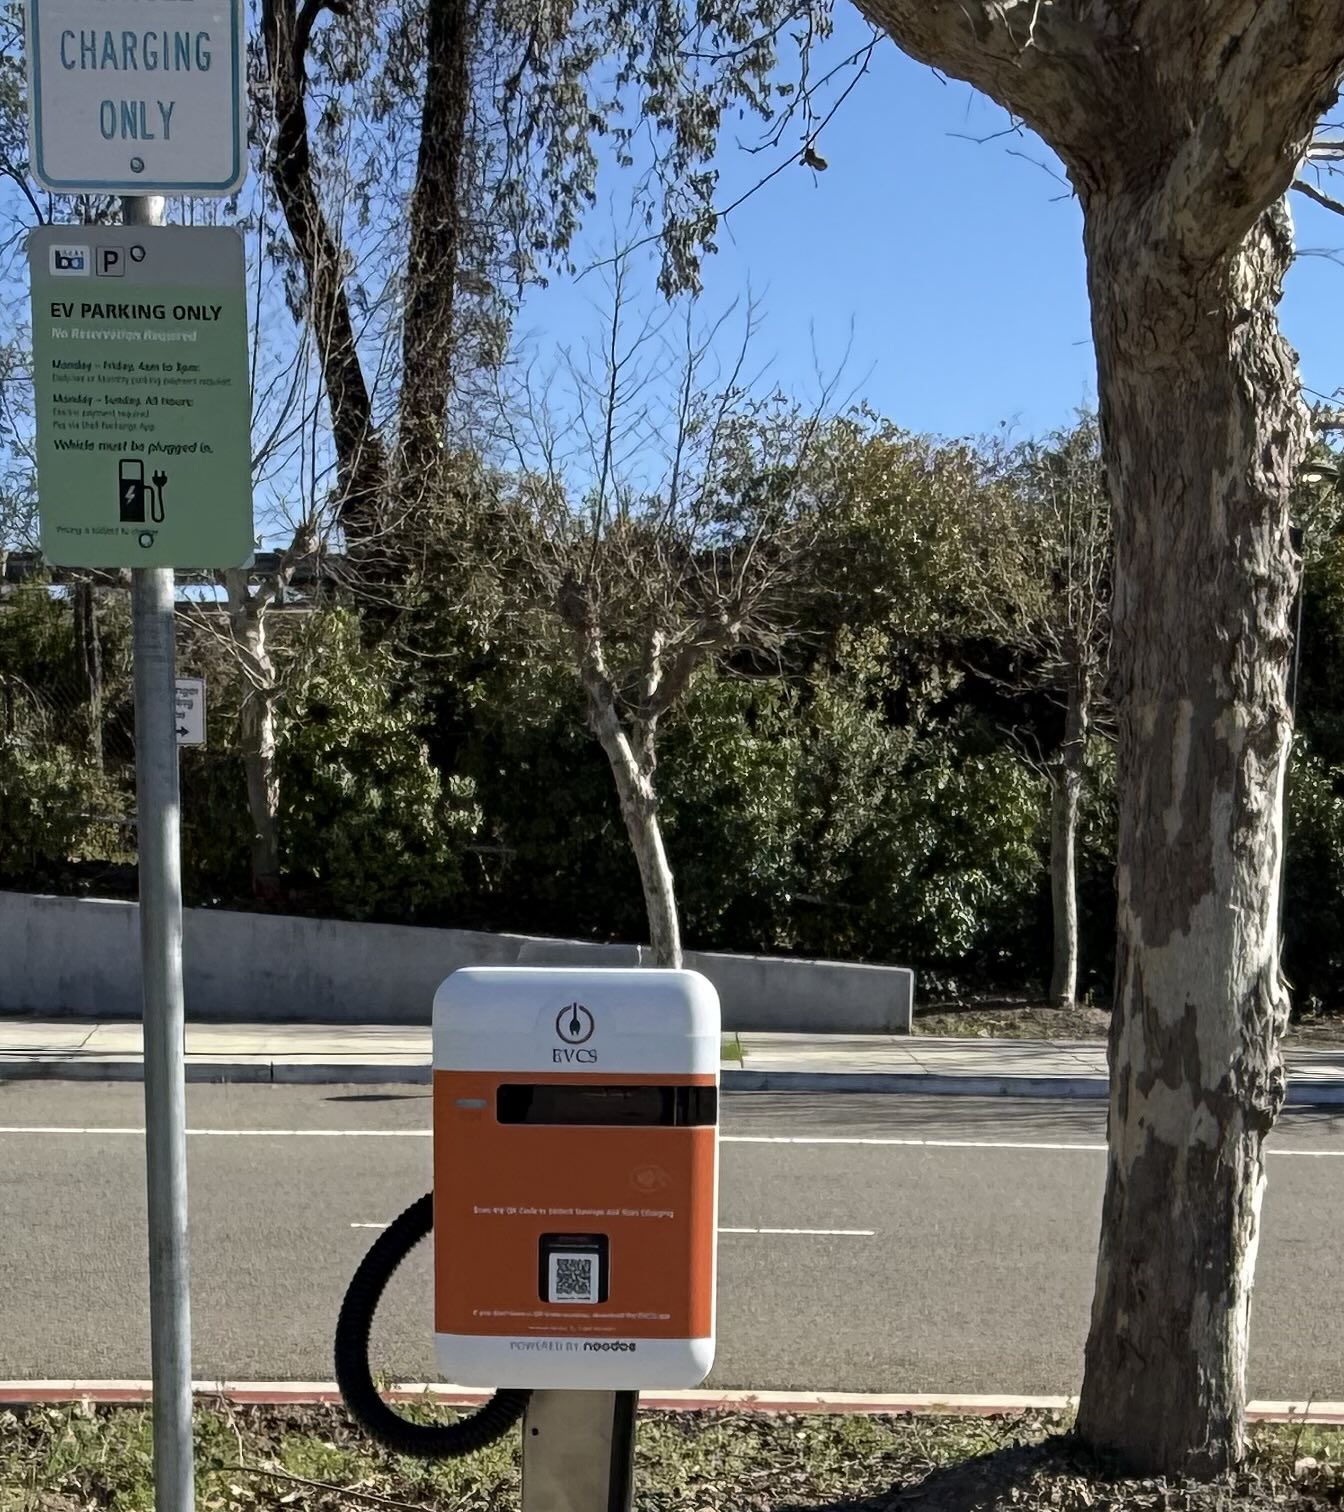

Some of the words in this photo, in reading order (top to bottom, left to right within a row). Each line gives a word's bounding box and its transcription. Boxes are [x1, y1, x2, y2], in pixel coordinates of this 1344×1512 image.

[60, 30, 212, 72] CHARGING
[99, 99, 176, 141] ONLY
[104, 250, 119, 273] P
[50, 302, 74, 319] EV
[81, 303, 166, 320] PARKING
[173, 305, 223, 321] ONLY
[51, 327, 68, 339] No
[52, 359, 92, 372] Monday
[162, 362, 173, 371] to
[53, 393, 93, 407] Monday
[53, 439, 94, 452] Vehicle
[98, 440, 127, 453] must
[131, 440, 145, 452] be
[147, 441, 197, 456] plugged
[552, 1048, 598, 1064] EVCS
